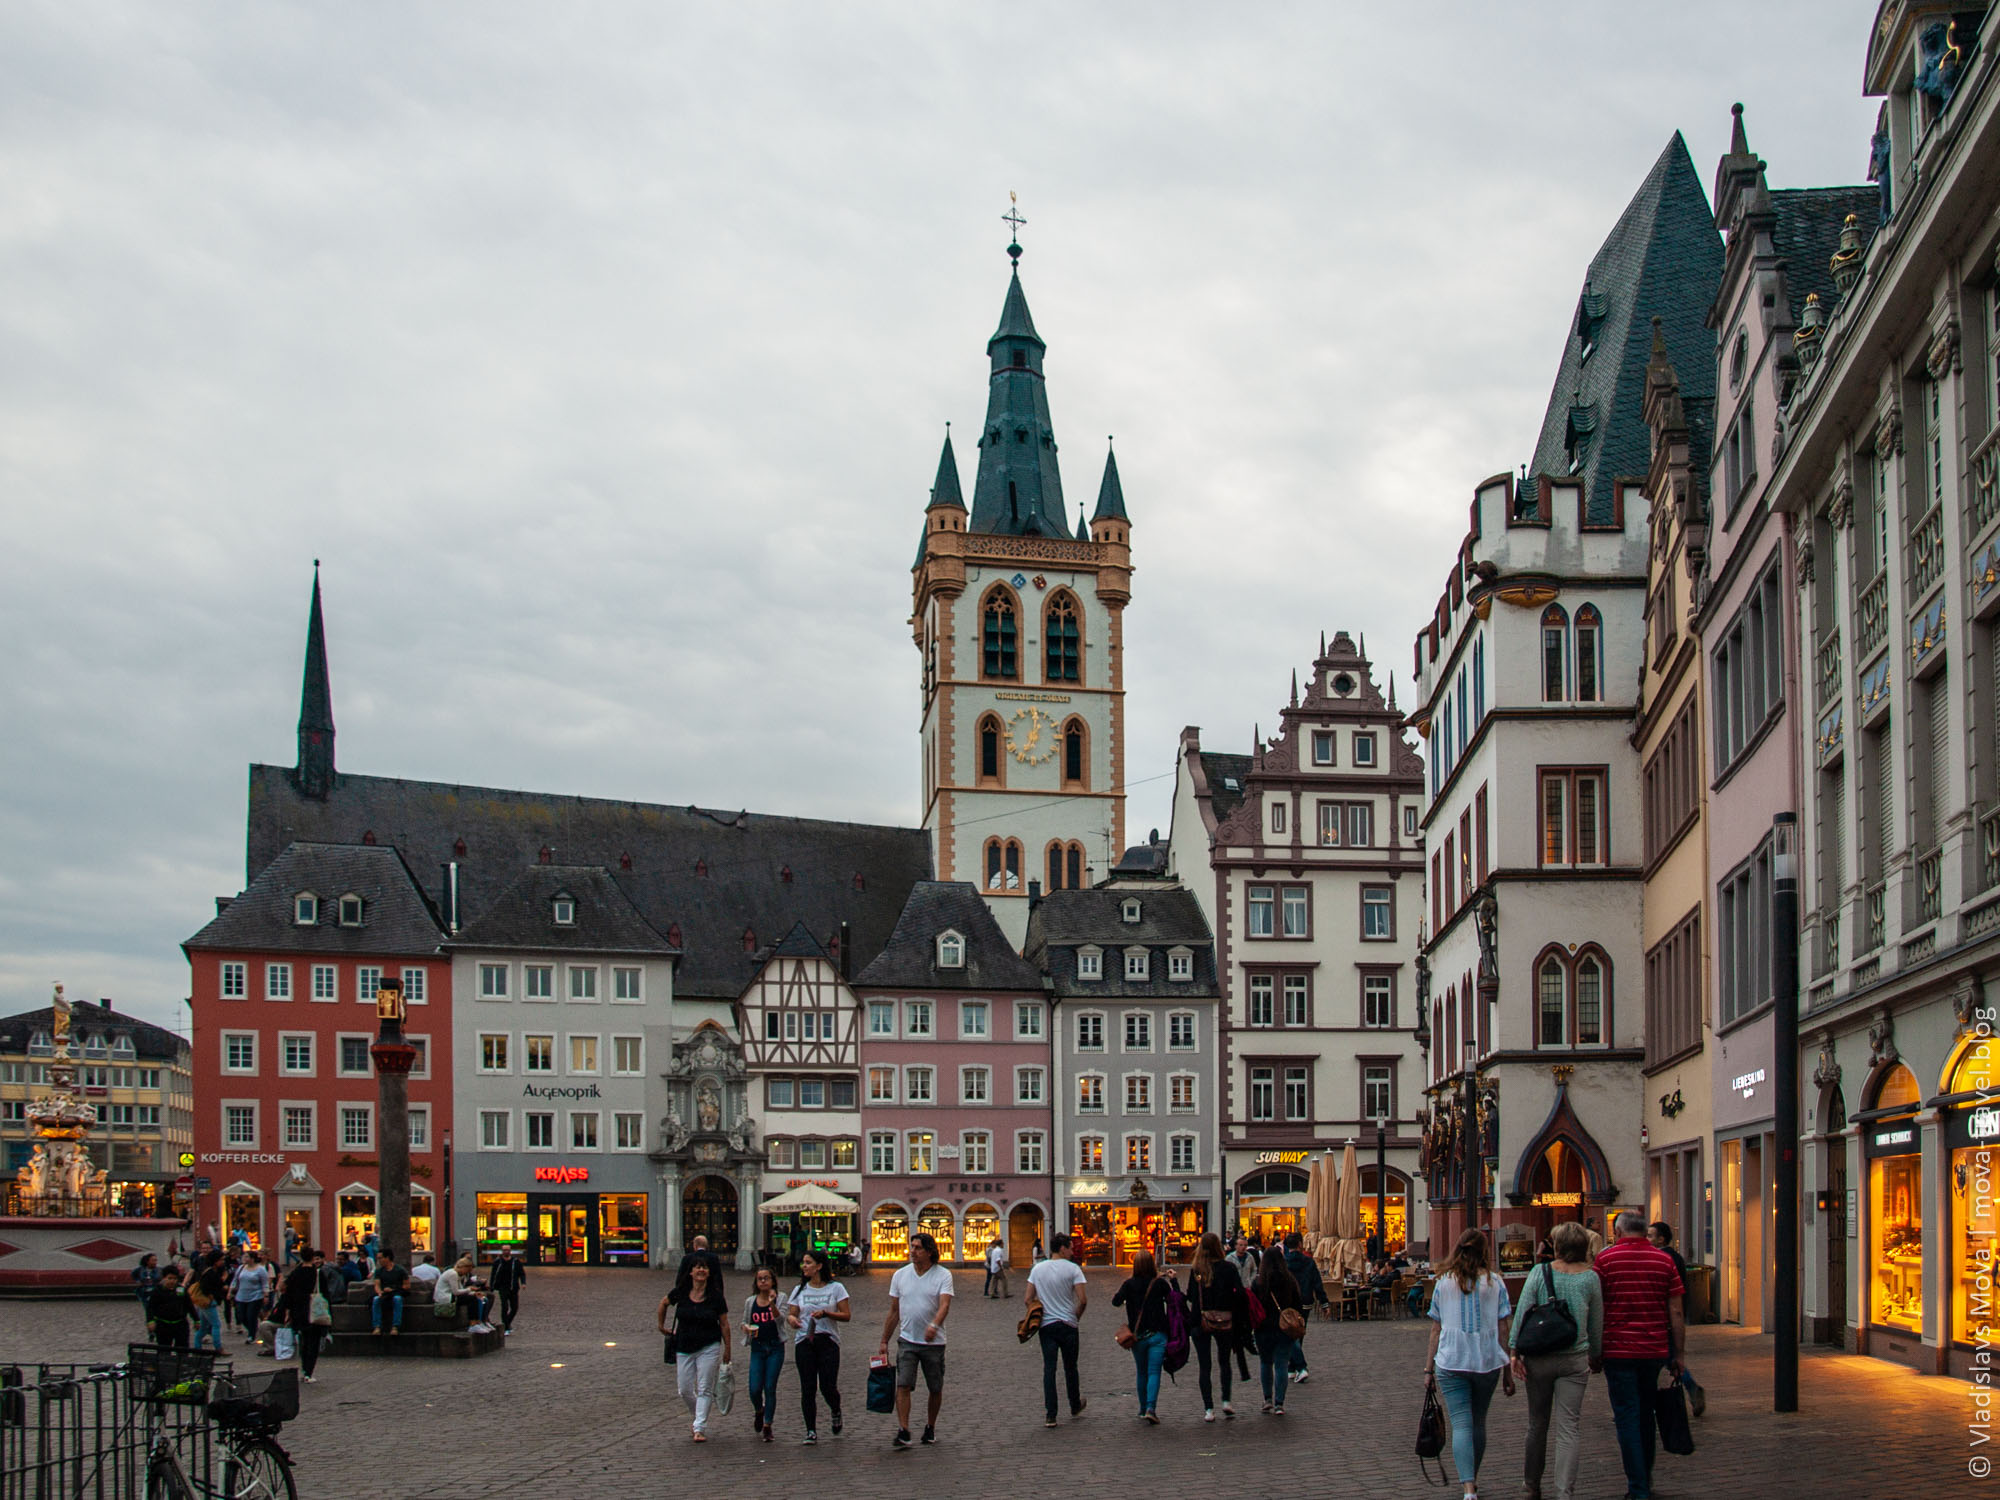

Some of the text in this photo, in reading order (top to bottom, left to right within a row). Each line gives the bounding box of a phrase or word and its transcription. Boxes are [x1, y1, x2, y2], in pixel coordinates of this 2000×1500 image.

[201, 1153, 285, 1163] KOFFER ECKE
[1255, 1151, 1309, 1164] SUBWAY
[535, 1165, 588, 1184] KRASS
